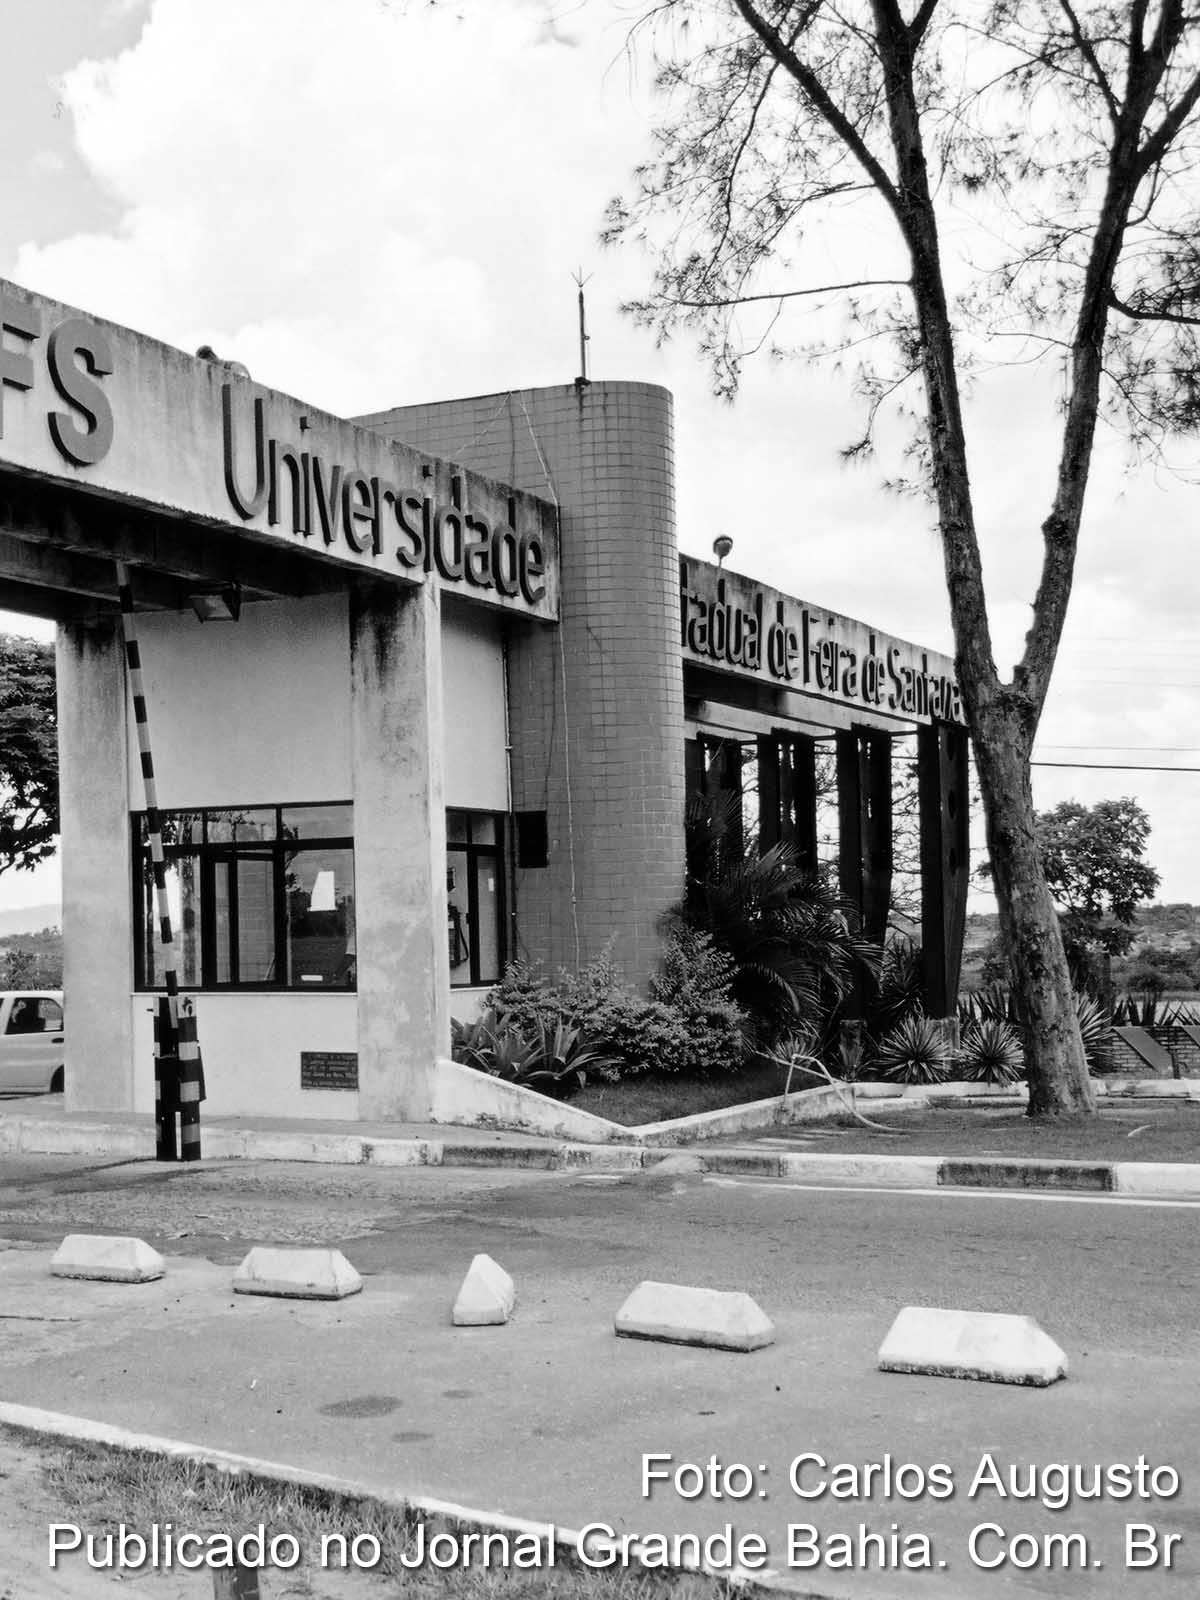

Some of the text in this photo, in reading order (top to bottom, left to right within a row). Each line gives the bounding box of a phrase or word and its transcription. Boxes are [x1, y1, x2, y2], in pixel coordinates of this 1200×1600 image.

[222, 383, 547, 605] Universidade
[768, 600, 800, 681] de
[802, 610, 858, 697] Feira
[862, 634, 886, 706] de
[887, 646, 963, 722] Santana
